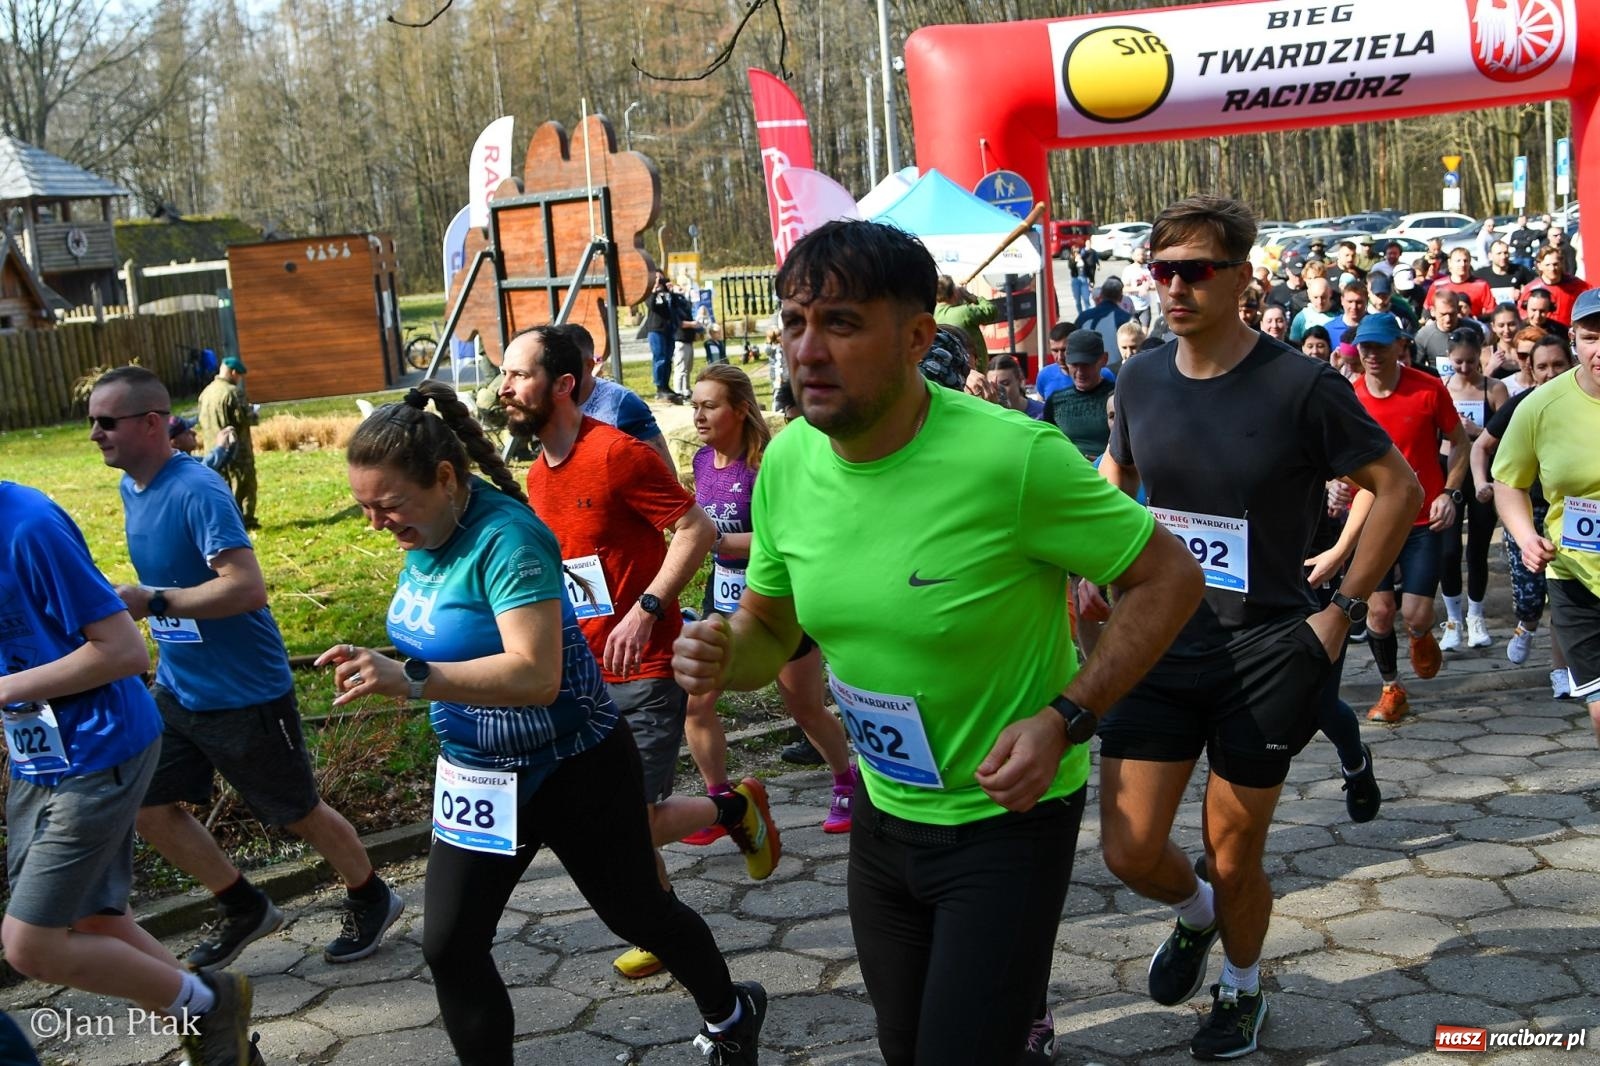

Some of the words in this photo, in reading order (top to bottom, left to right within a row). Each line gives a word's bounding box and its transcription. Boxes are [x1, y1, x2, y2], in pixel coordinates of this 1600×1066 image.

[1267, 4, 1354, 30] BIEG
[1197, 30, 1435, 76] TWARDZIELA
[1221, 72, 1411, 112] RACIBÓRZ
[1170, 514, 1189, 524] BIEG
[1191, 518, 1240, 531] TWARDZIELA
[721, 581, 747, 601] 08
[852, 693, 908, 711] TWARDZIELA
[13, 726, 51, 754] 022
[845, 709, 910, 760] 062
[457, 773, 508, 786] TWARDZIELA
[442, 790, 495, 829] 028
